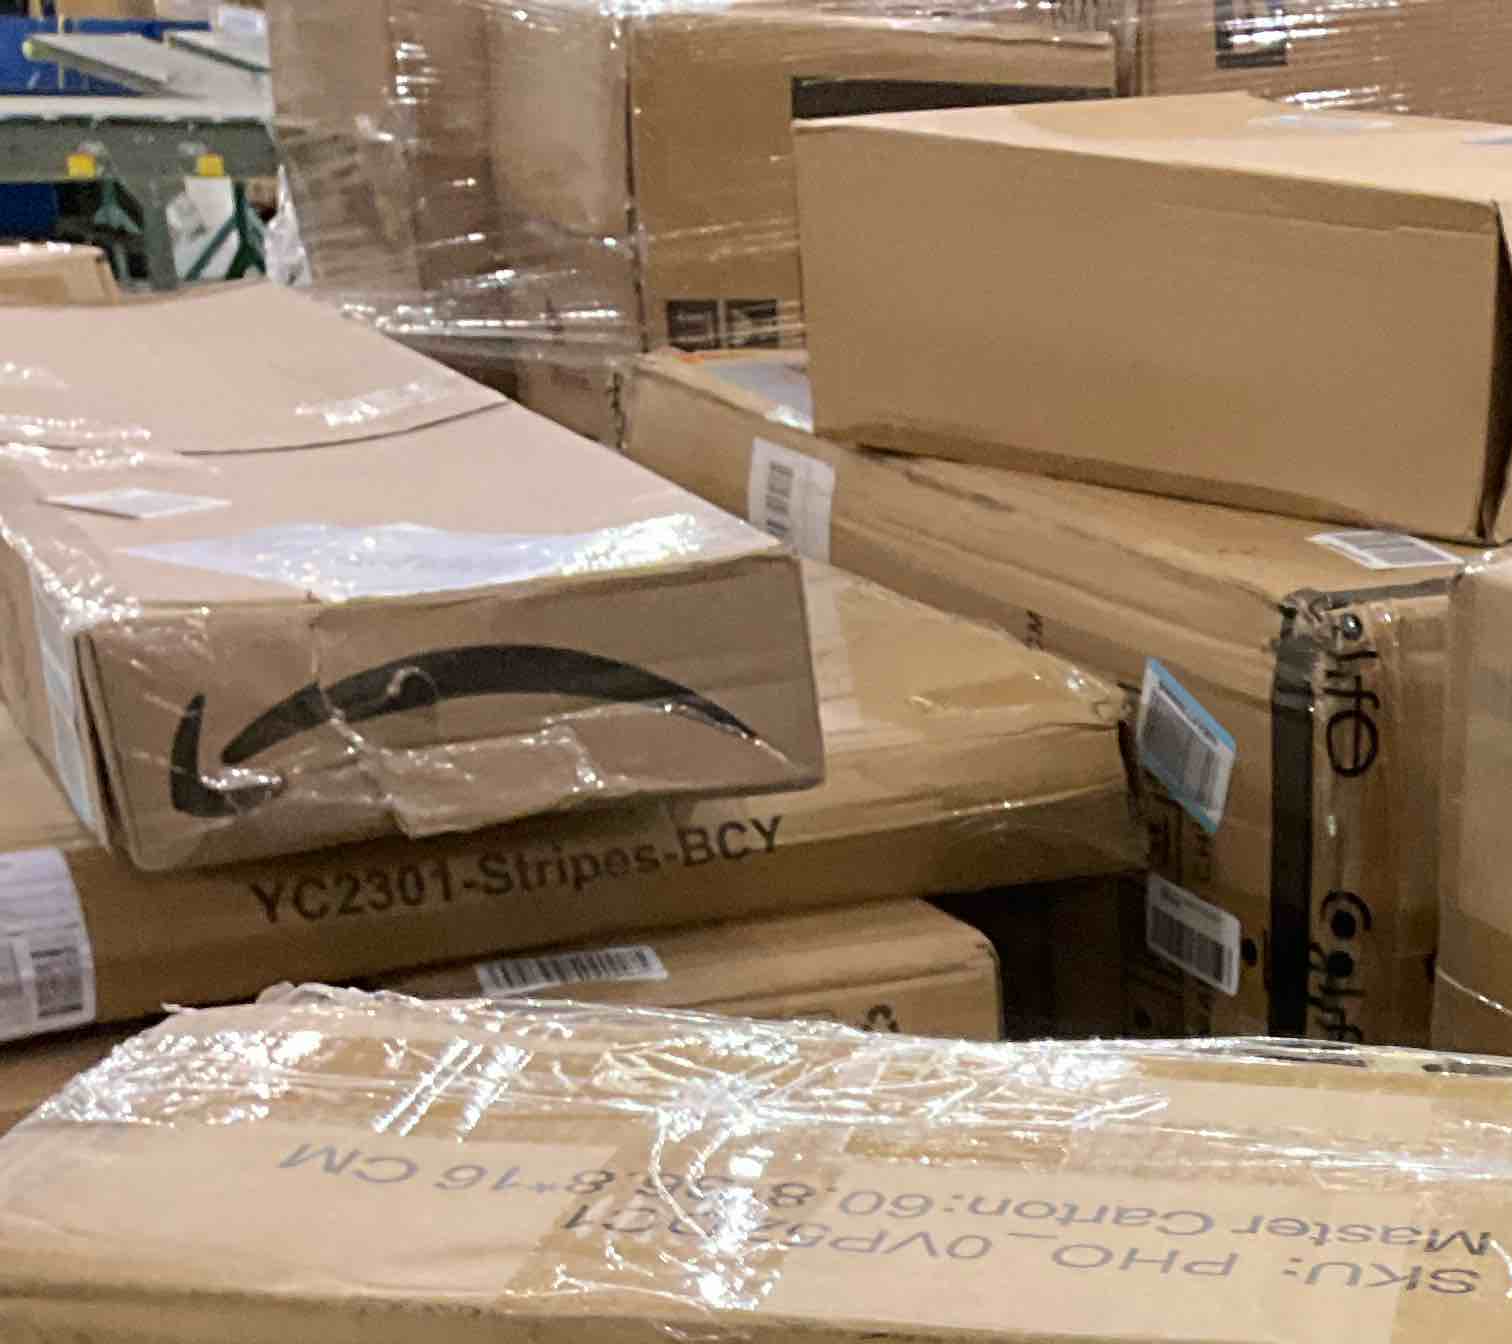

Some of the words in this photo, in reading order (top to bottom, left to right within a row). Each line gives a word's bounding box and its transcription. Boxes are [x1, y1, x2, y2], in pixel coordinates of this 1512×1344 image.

[249, 815, 783, 923] YC2301-Stripes-BCY
[279, 1142, 420, 1185] CM
[1231, 1215, 1494, 1256] Master
[1280, 1257, 1483, 1296] SKU:
